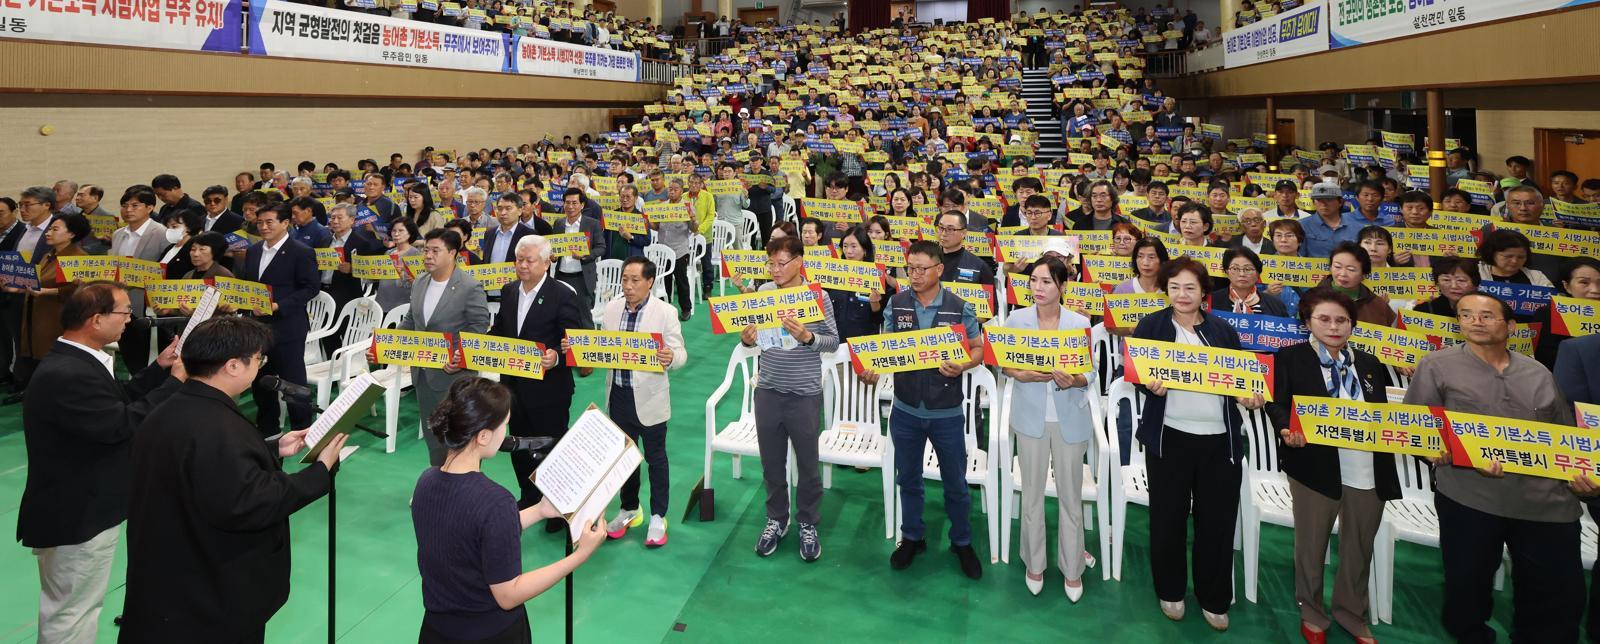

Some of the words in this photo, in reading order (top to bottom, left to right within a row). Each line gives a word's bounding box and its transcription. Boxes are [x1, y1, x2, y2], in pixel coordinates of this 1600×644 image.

[102, 0, 160, 23] 시범사업
[166, 0, 191, 25] 무주
[195, 1, 223, 29] 유치!
[1339, 1, 1345, 26] 전
[1346, 0, 1365, 25] 군민의
[1413, 11, 1444, 30] 설천면민
[1448, 6, 1466, 24] 일동
[1281, 18, 1296, 42] 무주가
[1297, 9, 1318, 38] 답이다!
[272, 11, 296, 36] 지역
[299, 15, 350, 42] 균형발전의
[353, 21, 380, 45] 첫걸음
[383, 25, 408, 48] 농어촌
[410, 29, 442, 52] 기본소득,
[444, 33, 471, 54] 무주에서
[472, 37, 500, 57] 보여주자!
[382, 51, 411, 63] 무주읍민
[415, 54, 428, 64] 일동
[522, 43, 536, 60] 농어촌
[538, 45, 556, 62] 기본소득
[810, 210, 834, 218] 자연특별시
[836, 210, 852, 219] 무주로
[1443, 215, 1472, 223] 기본소득
[549, 237, 568, 246] 기본소득
[964, 235, 993, 244] 시범사업을
[1409, 231, 1438, 241] 기본소득
[1442, 233, 1479, 243] 시범사업을
[1526, 229, 1560, 240] 기본소득
[1564, 232, 1600, 245] 시범사업
[569, 244, 582, 252] 무주로
[879, 244, 907, 254] 시범사업을
[1397, 242, 1435, 252] 자연특별시
[1438, 243, 1464, 253] 무주로
[1557, 242, 1588, 255] 무주로
[724, 254, 741, 262] 농어촌
[744, 254, 768, 263] 기본소득
[875, 253, 895, 262] 무주로
[1183, 250, 1210, 259] 기본소득
[60, 260, 80, 269] 농어촌
[82, 260, 106, 269] 기본소득
[734, 265, 765, 275] 자연특별시
[803, 260, 823, 270] 농어촌
[825, 261, 850, 273] 기본소득
[852, 266, 883, 277] 시범사업을
[1086, 259, 1105, 268] 농어촌
[1281, 260, 1312, 271] 기본소득
[73, 269, 101, 280] 자연특별시
[478, 267, 497, 275] 기본소득
[1098, 271, 1132, 281] 자연특별시
[814, 274, 846, 286] 자연특별시
[848, 278, 871, 290] 무주로
[1268, 272, 1308, 284] 자연특별시
[1384, 273, 1416, 283] 기본소득
[158, 284, 180, 293] 기본소득
[215, 282, 231, 291] 농어촌
[233, 284, 250, 293] 기본소득
[956, 288, 991, 300] 시범사업을
[1373, 285, 1413, 296] 자연특별시
[176, 294, 197, 304] 무주로
[224, 295, 248, 305] 자연특별시
[249, 297, 265, 308] 무주로
[713, 302, 739, 315] 농어촌
[742, 297, 776, 310] 기본소득
[779, 289, 820, 305] 시범사업을
[1066, 299, 1092, 311] 무주로
[1108, 300, 1130, 309] 농어촌
[1134, 299, 1165, 309] 기본소득
[980, 303, 988, 313] !!!
[1555, 302, 1593, 317] 농어촌
[731, 313, 774, 328] 자연특별시
[776, 307, 806, 321] 무주로
[808, 305, 819, 318] !!!
[1402, 315, 1434, 328] 농어촌
[1254, 320, 1308, 335] 기본소득은
[375, 334, 394, 345] 농어촌
[396, 335, 419, 346] 기본소득
[422, 337, 451, 350] 시범사업을
[568, 335, 590, 346] 농어촌
[594, 336, 623, 348] 기본소득
[625, 338, 660, 350] 시범사업을
[852, 341, 878, 354] 농어촌
[881, 337, 917, 351] 기본소득
[920, 332, 962, 347] 시범사업을
[988, 332, 1016, 346] 농어촌
[1021, 335, 1060, 349] 기본소득
[1387, 332, 1436, 352] 시범사업을
[461, 338, 481, 350] 농어촌
[484, 340, 511, 353] 기본소득
[513, 345, 544, 359] 시범사업을
[1379, 345, 1416, 364] 무주로
[383, 349, 415, 361] 자연특별시
[417, 349, 438, 363] 무주로
[440, 353, 449, 365] !!!
[582, 352, 619, 364] 자연특별시
[622, 351, 647, 365] 무주로
[650, 355, 660, 366] !!!
[871, 353, 916, 369] 자연특별시
[918, 350, 950, 365] 무주로
[953, 348, 964, 360] !!!
[1006, 351, 1055, 368] 자연특별시
[1059, 353, 1085, 369] 무주로
[1128, 345, 1160, 360] 농어촌
[1165, 350, 1208, 366] 기본소득
[1213, 355, 1268, 375] 시범사업을
[472, 355, 506, 370] 자연특별시
[507, 357, 531, 373] 무주로
[532, 363, 541, 374] !!!
[1148, 366, 1202, 385] 자연특별시
[1207, 371, 1247, 391] 무주로
[1251, 379, 1264, 394] !!!
[1296, 403, 1329, 418] 농어촌
[1335, 406, 1382, 424] 기본소득
[1386, 411, 1443, 430] 시범사업을
[1315, 424, 1376, 444] 자연특별시
[1380, 430, 1423, 447] 무주로
[1427, 436, 1441, 451] !!!
[1451, 420, 1490, 439] 농어촌
[1494, 425, 1552, 446] 기본소득
[1480, 447, 1548, 470] 자연특별시
